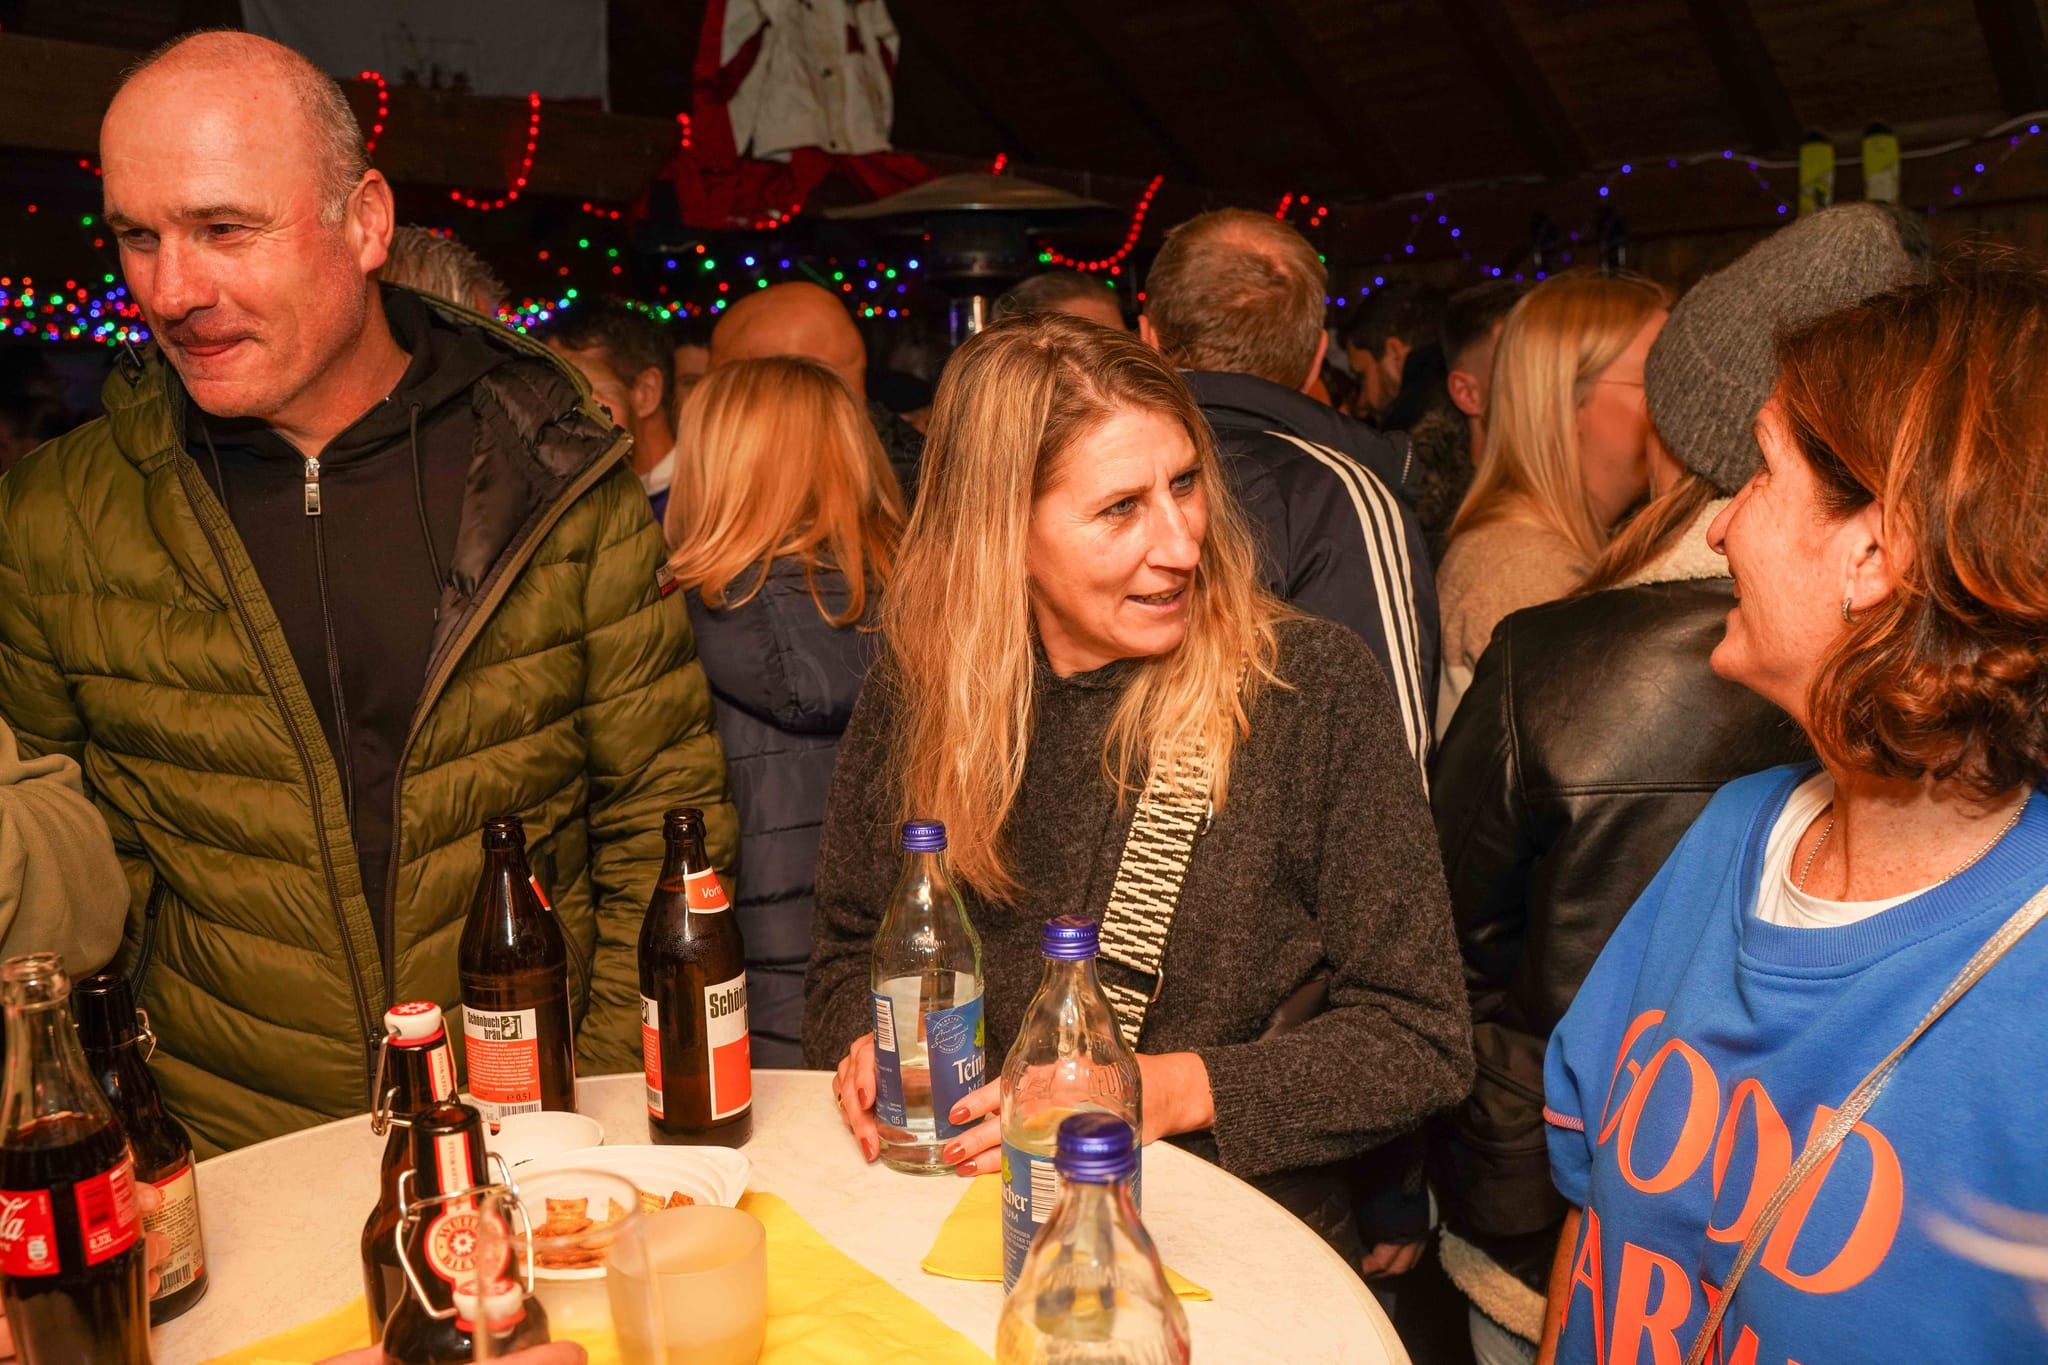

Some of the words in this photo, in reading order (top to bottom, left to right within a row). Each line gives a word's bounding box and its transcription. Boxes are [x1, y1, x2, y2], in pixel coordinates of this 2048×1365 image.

[467, 1011, 500, 1028] Schönbuch
[484, 1027, 501, 1040] bräu
[1598, 1009, 1904, 1294] GOOD
